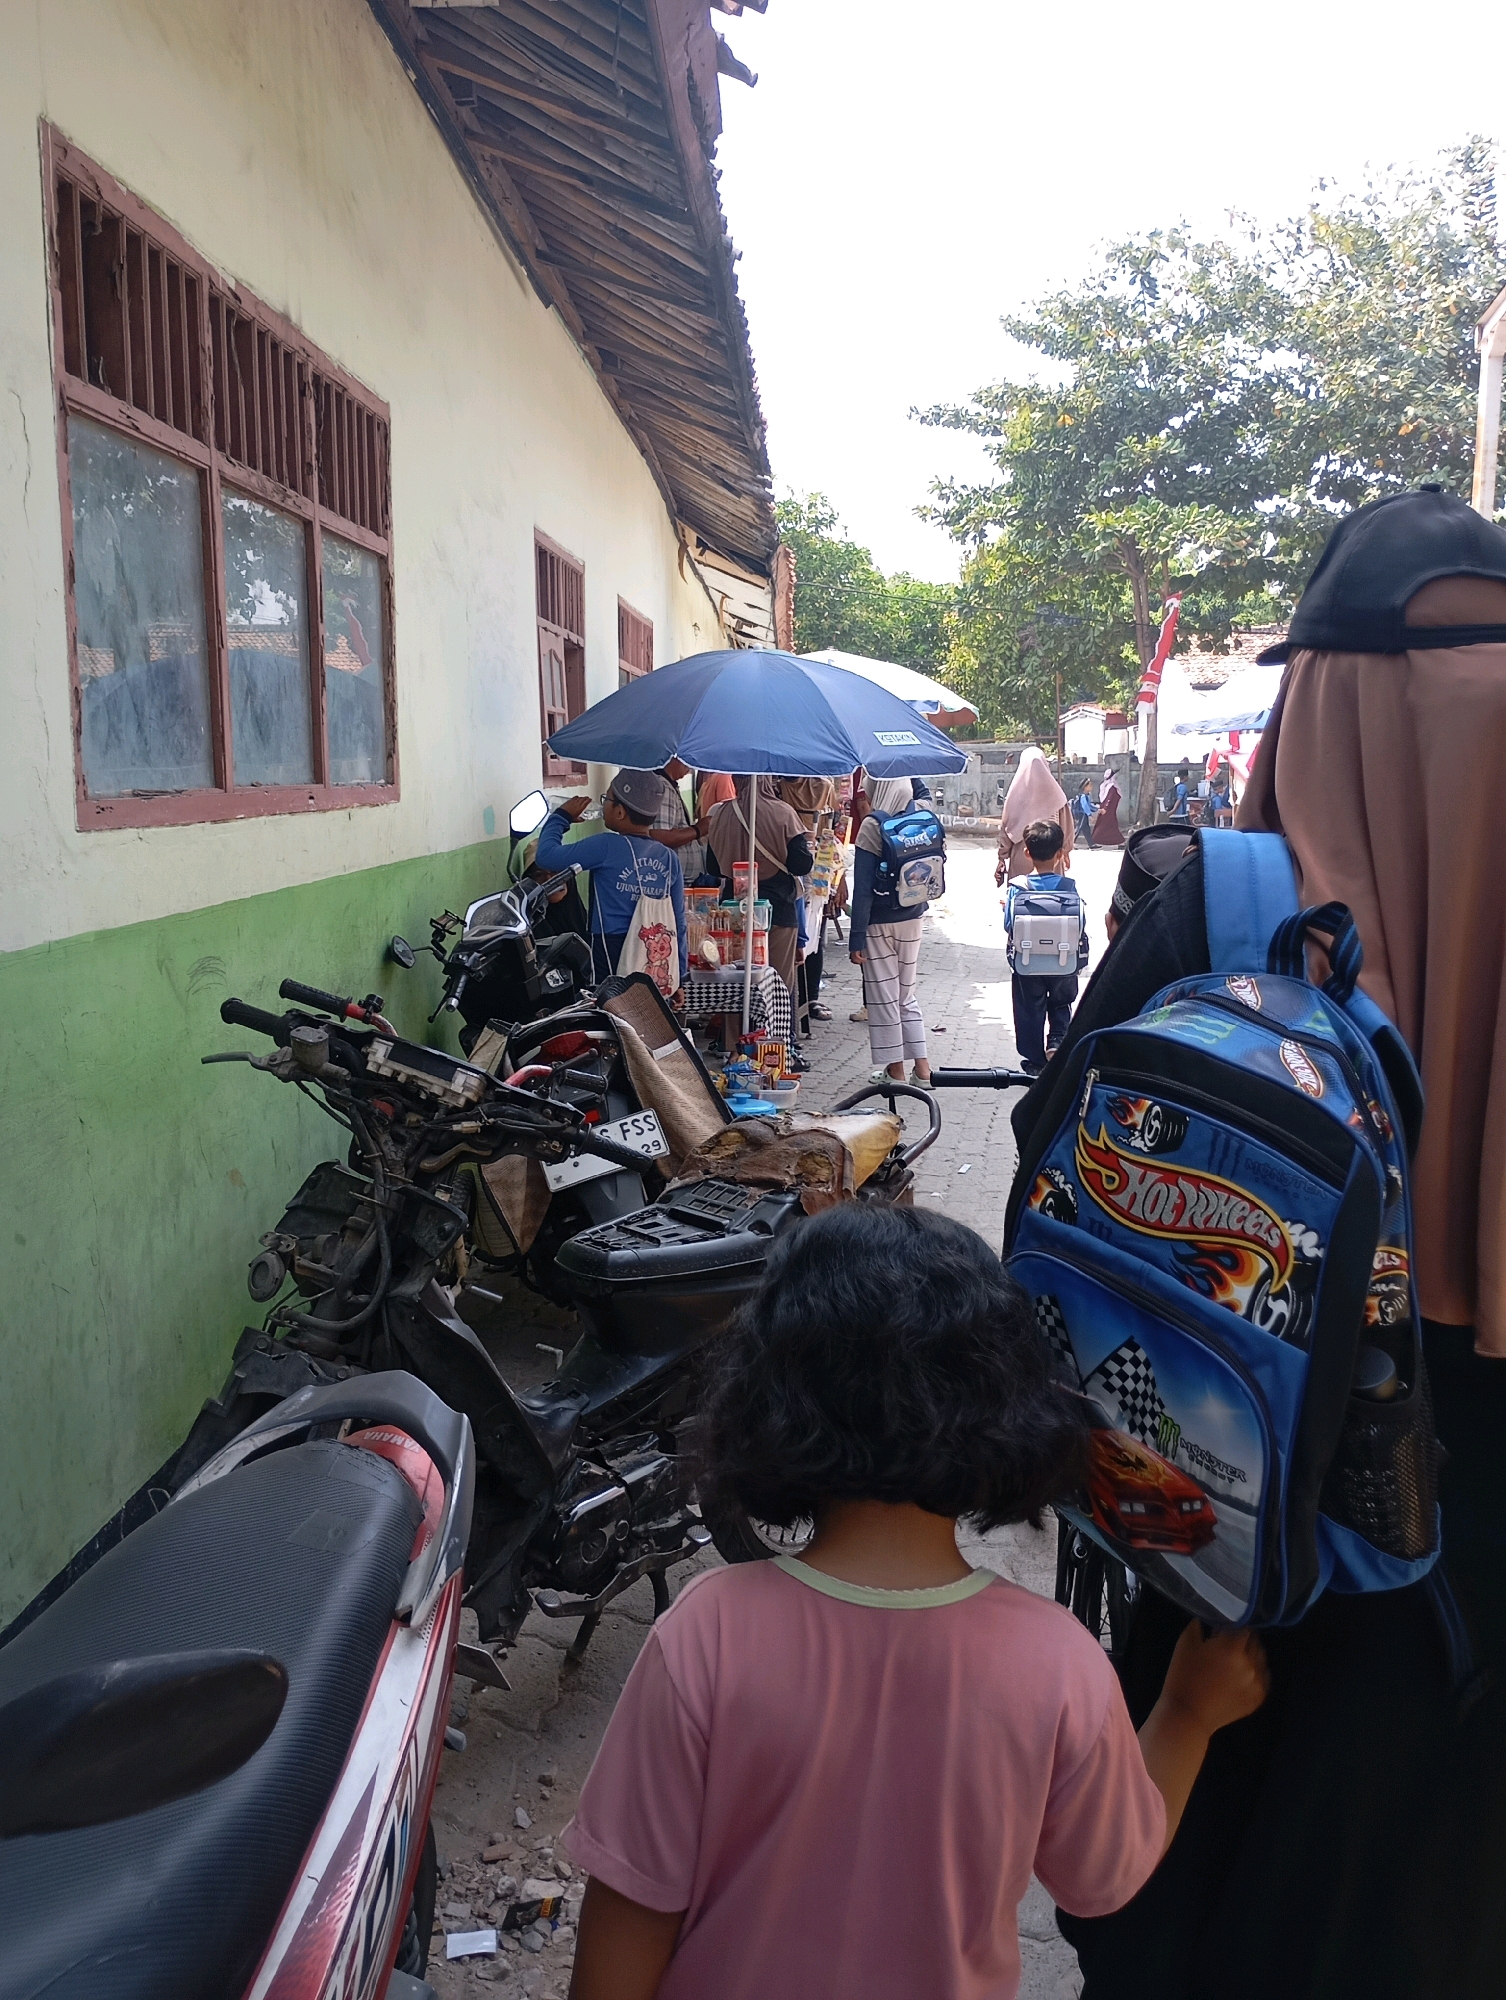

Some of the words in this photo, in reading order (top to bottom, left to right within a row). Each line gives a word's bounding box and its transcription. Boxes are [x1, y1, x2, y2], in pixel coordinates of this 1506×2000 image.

[618, 1114, 656, 1141] FSS
[641, 1140, 662, 1153] 29
[1244, 1158, 1328, 1200] MONSTER
[363, 1431, 420, 1453] YAMAHA
[1180, 1437, 1246, 1483] MONSTER
